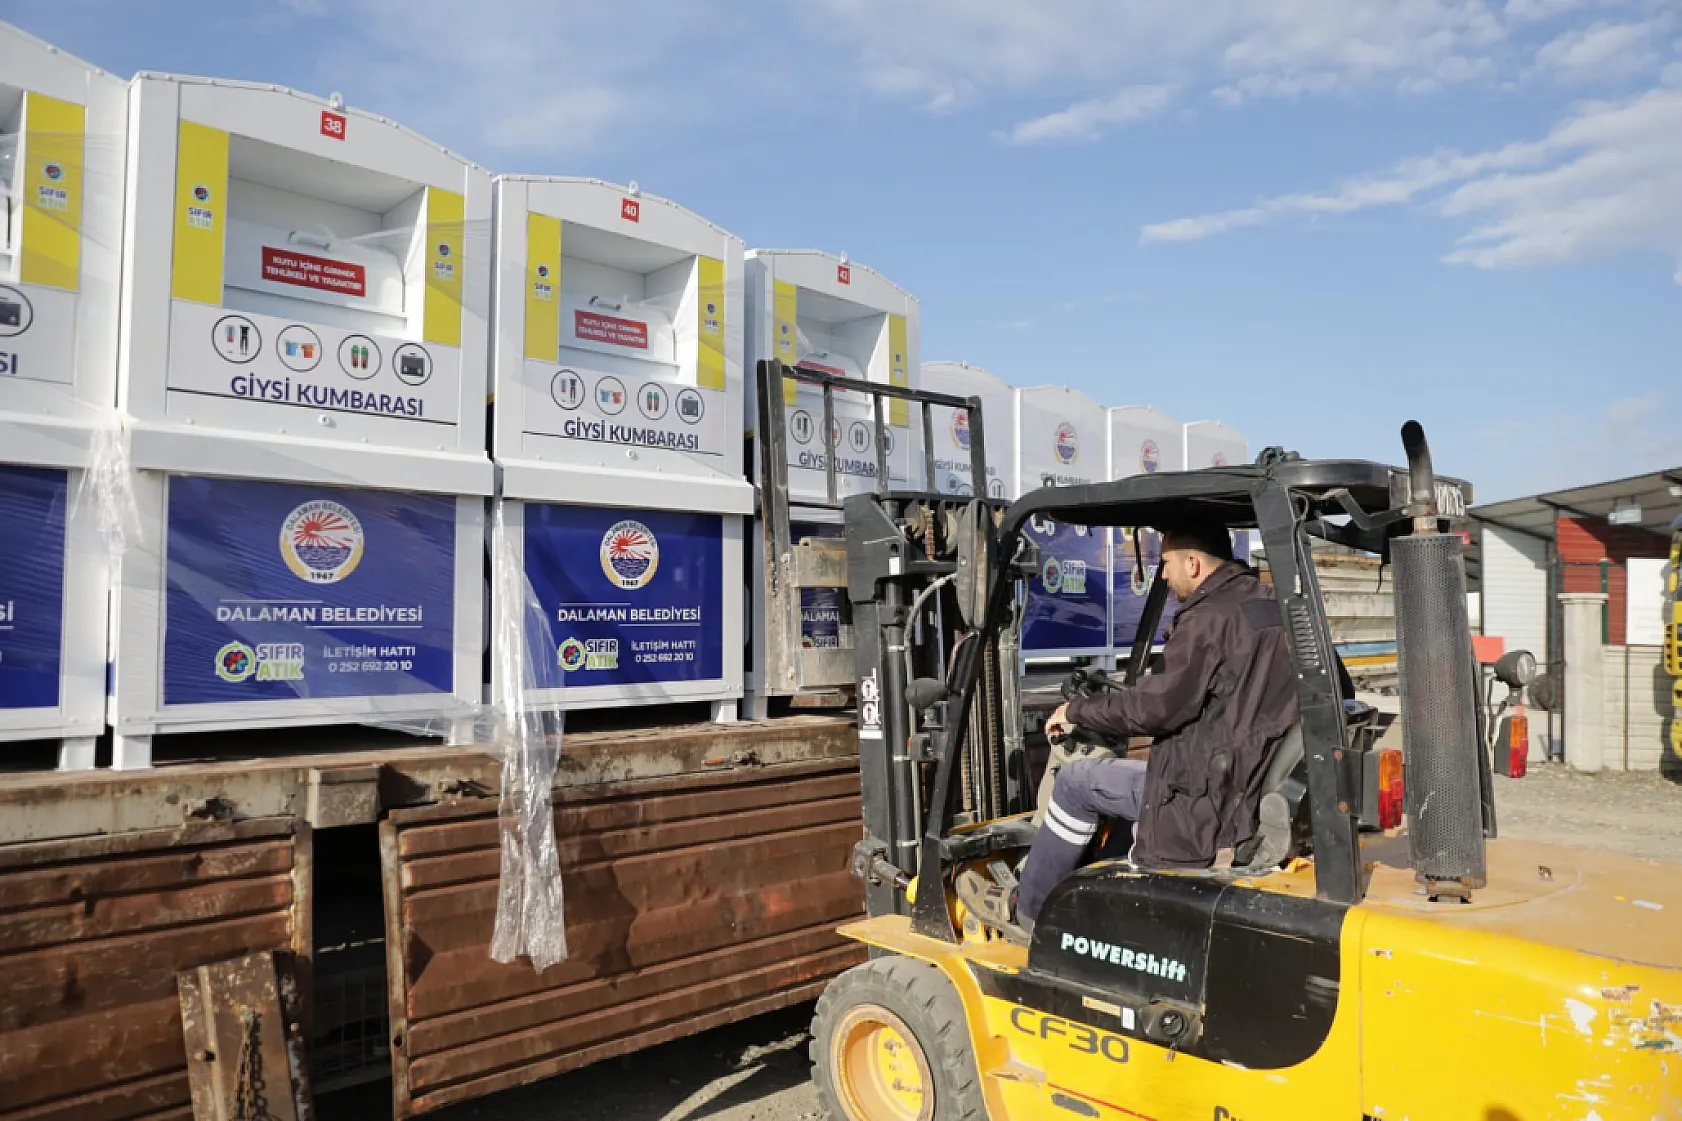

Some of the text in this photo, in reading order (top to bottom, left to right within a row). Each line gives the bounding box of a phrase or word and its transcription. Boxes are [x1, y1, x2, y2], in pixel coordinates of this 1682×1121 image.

[323, 117, 343, 134] 38
[188, 206, 213, 219] SIFIR
[624, 204, 637, 217] 40
[272, 256, 297, 267] KUTU
[309, 274, 320, 284] VE
[230, 373, 423, 417] GİYSİ KUMBARASI
[563, 416, 699, 450] GİYSİ KUMBARASI
[798, 448, 826, 469] GİYS
[216, 604, 423, 622] DALAMAN BELEDİYESİ
[558, 606, 701, 622] DALAMAN BELEDİYESİ
[380, 646, 416, 657] HATTI
[586, 640, 617, 652] SIFIR
[671, 639, 696, 650] HATTI
[256, 644, 302, 661] SIFIR
[674, 652, 684, 661] 20
[685, 652, 694, 661] 10
[339, 661, 359, 673] 252
[361, 660, 382, 672] 692
[384, 660, 397, 671] 20
[399, 660, 413, 671] 10
[587, 654, 618, 668] ATIK
[257, 661, 303, 679] ATIK
[1060, 932, 1188, 982] POWERShift
[1010, 1007, 1129, 1063] CF30
